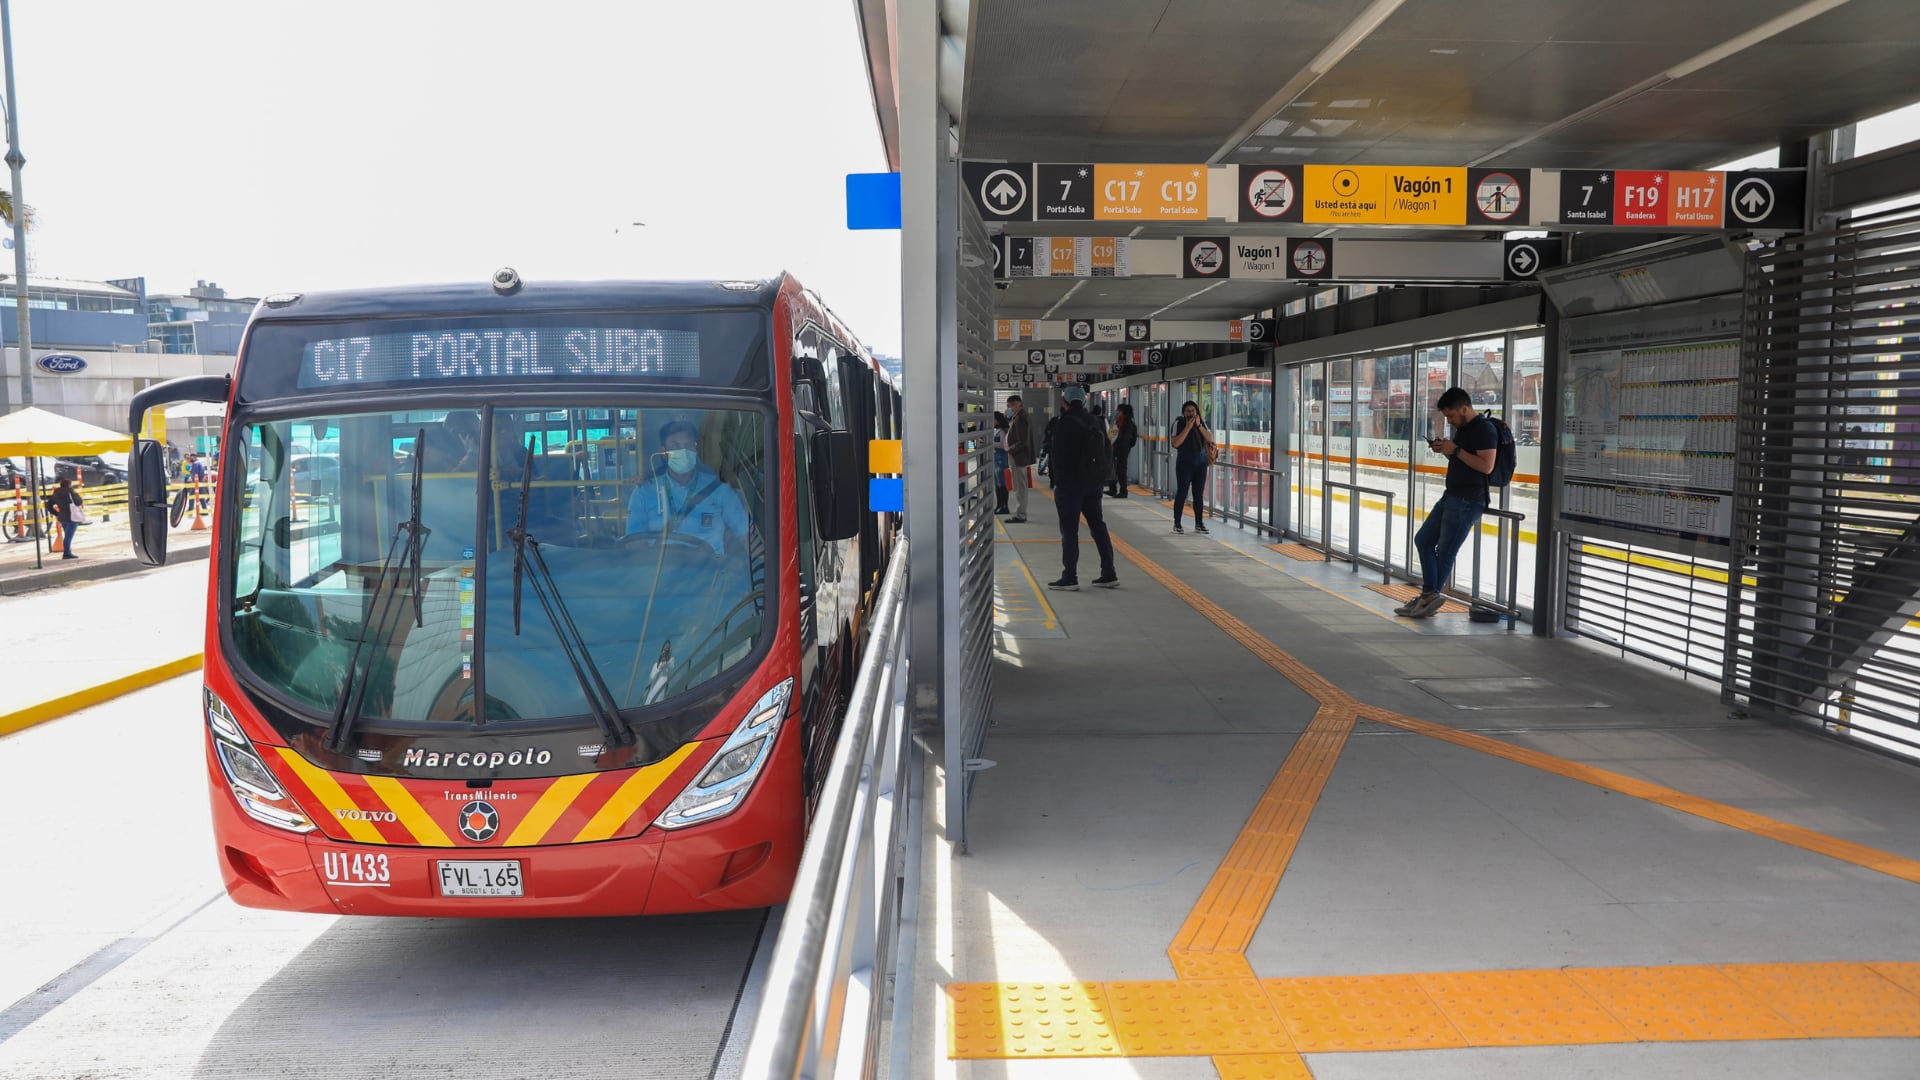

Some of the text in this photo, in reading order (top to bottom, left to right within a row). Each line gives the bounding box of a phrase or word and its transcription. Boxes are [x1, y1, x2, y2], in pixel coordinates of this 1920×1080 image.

[1060, 180, 1072, 200] 7
[1104, 180, 1141, 201] C17
[1161, 180, 1198, 202] C19
[1394, 176, 1452, 197] Vagón 1
[1582, 186, 1593, 206] 7
[1625, 186, 1658, 207] F19
[1677, 187, 1714, 208] H17
[1046, 205, 1085, 213] Portal Suba
[1104, 206, 1142, 214] Portal Suba
[1160, 206, 1198, 214] Portal Suba
[1315, 200, 1338, 209] Usted
[1340, 200, 1357, 209] está
[1433, 200, 1437, 210] 1
[1567, 210, 1606, 219] Santa Isabel
[1626, 212, 1656, 220] Banderas
[1676, 212, 1695, 220] Portal
[1018, 248, 1025, 260] 7
[1052, 248, 1072, 260] C17
[1093, 246, 1113, 257] C19
[1238, 245, 1280, 260] Vagón 1
[1098, 324, 1117, 332] Vagón
[314, 329, 664, 381] C17 PORTAL SUBA
[49, 357, 79, 370] Ford
[403, 748, 552, 768] Marcopolo
[444, 791, 517, 800] TransMilenio
[334, 808, 397, 822] VOLVO
[324, 852, 390, 882] U1433
[441, 868, 519, 887] FVL 165
